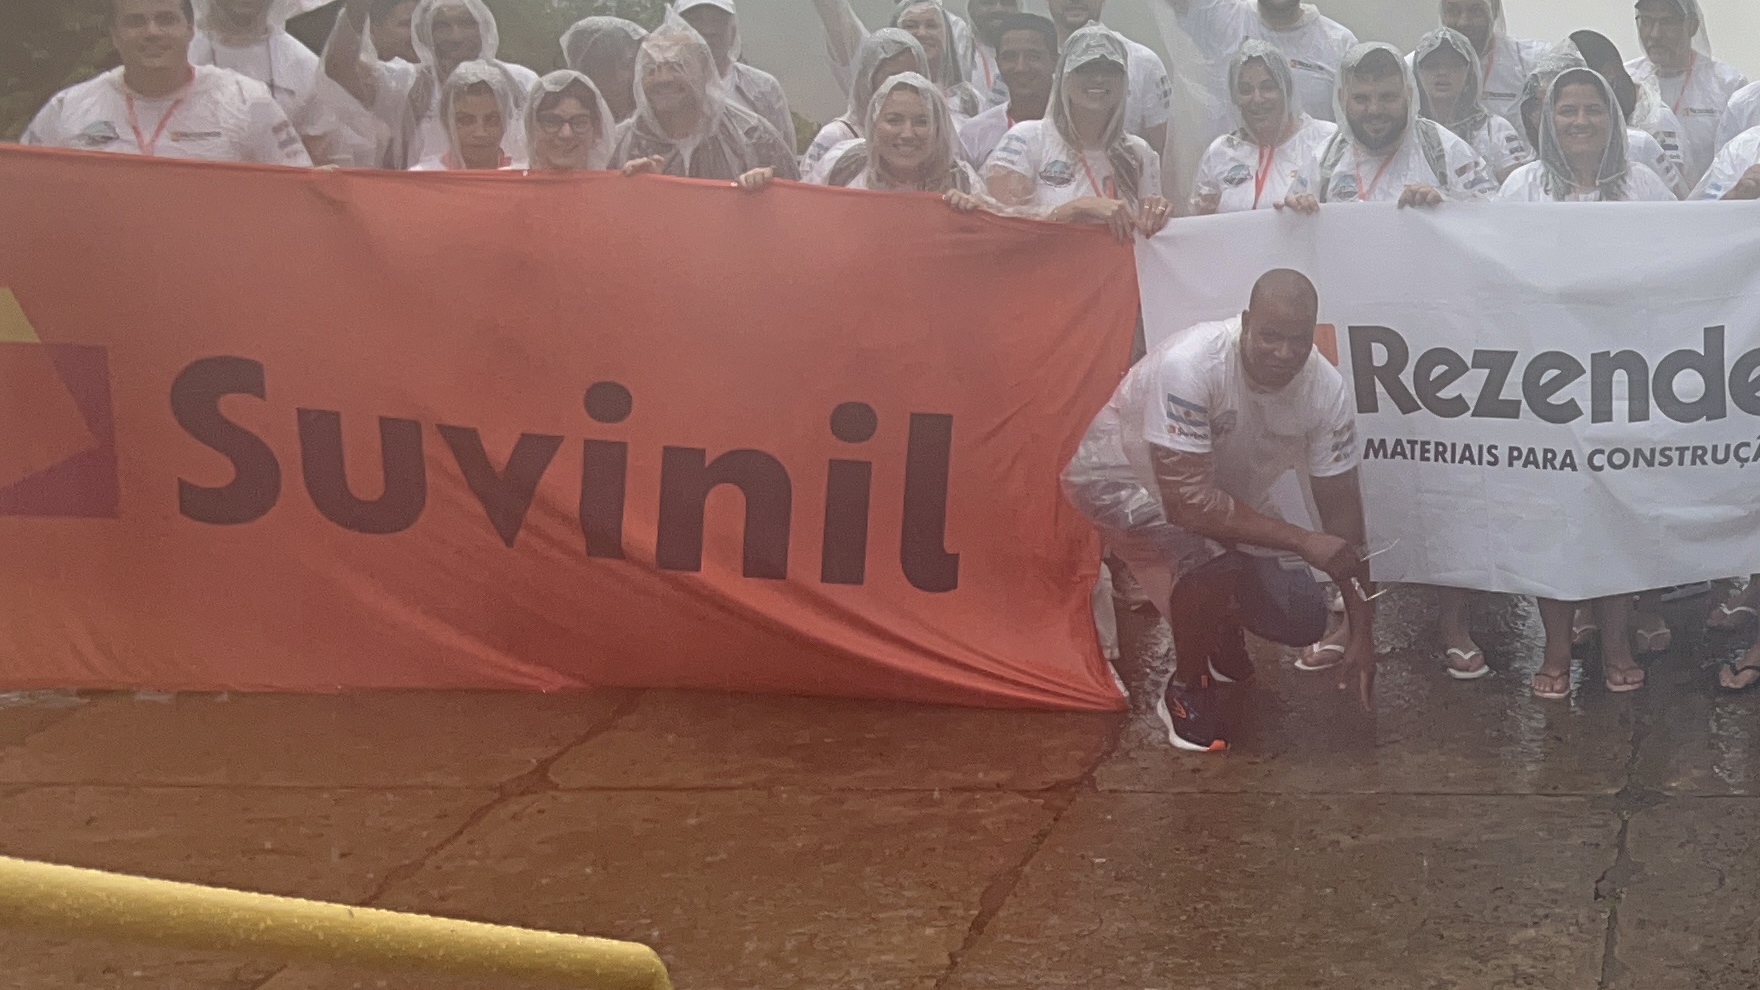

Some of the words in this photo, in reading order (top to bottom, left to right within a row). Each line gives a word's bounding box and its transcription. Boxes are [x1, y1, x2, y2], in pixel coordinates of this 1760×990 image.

[170, 355, 959, 593] Suvinil
[1363, 438, 1499, 467] MATERIAIS
[1508, 445, 1578, 472] PARA
